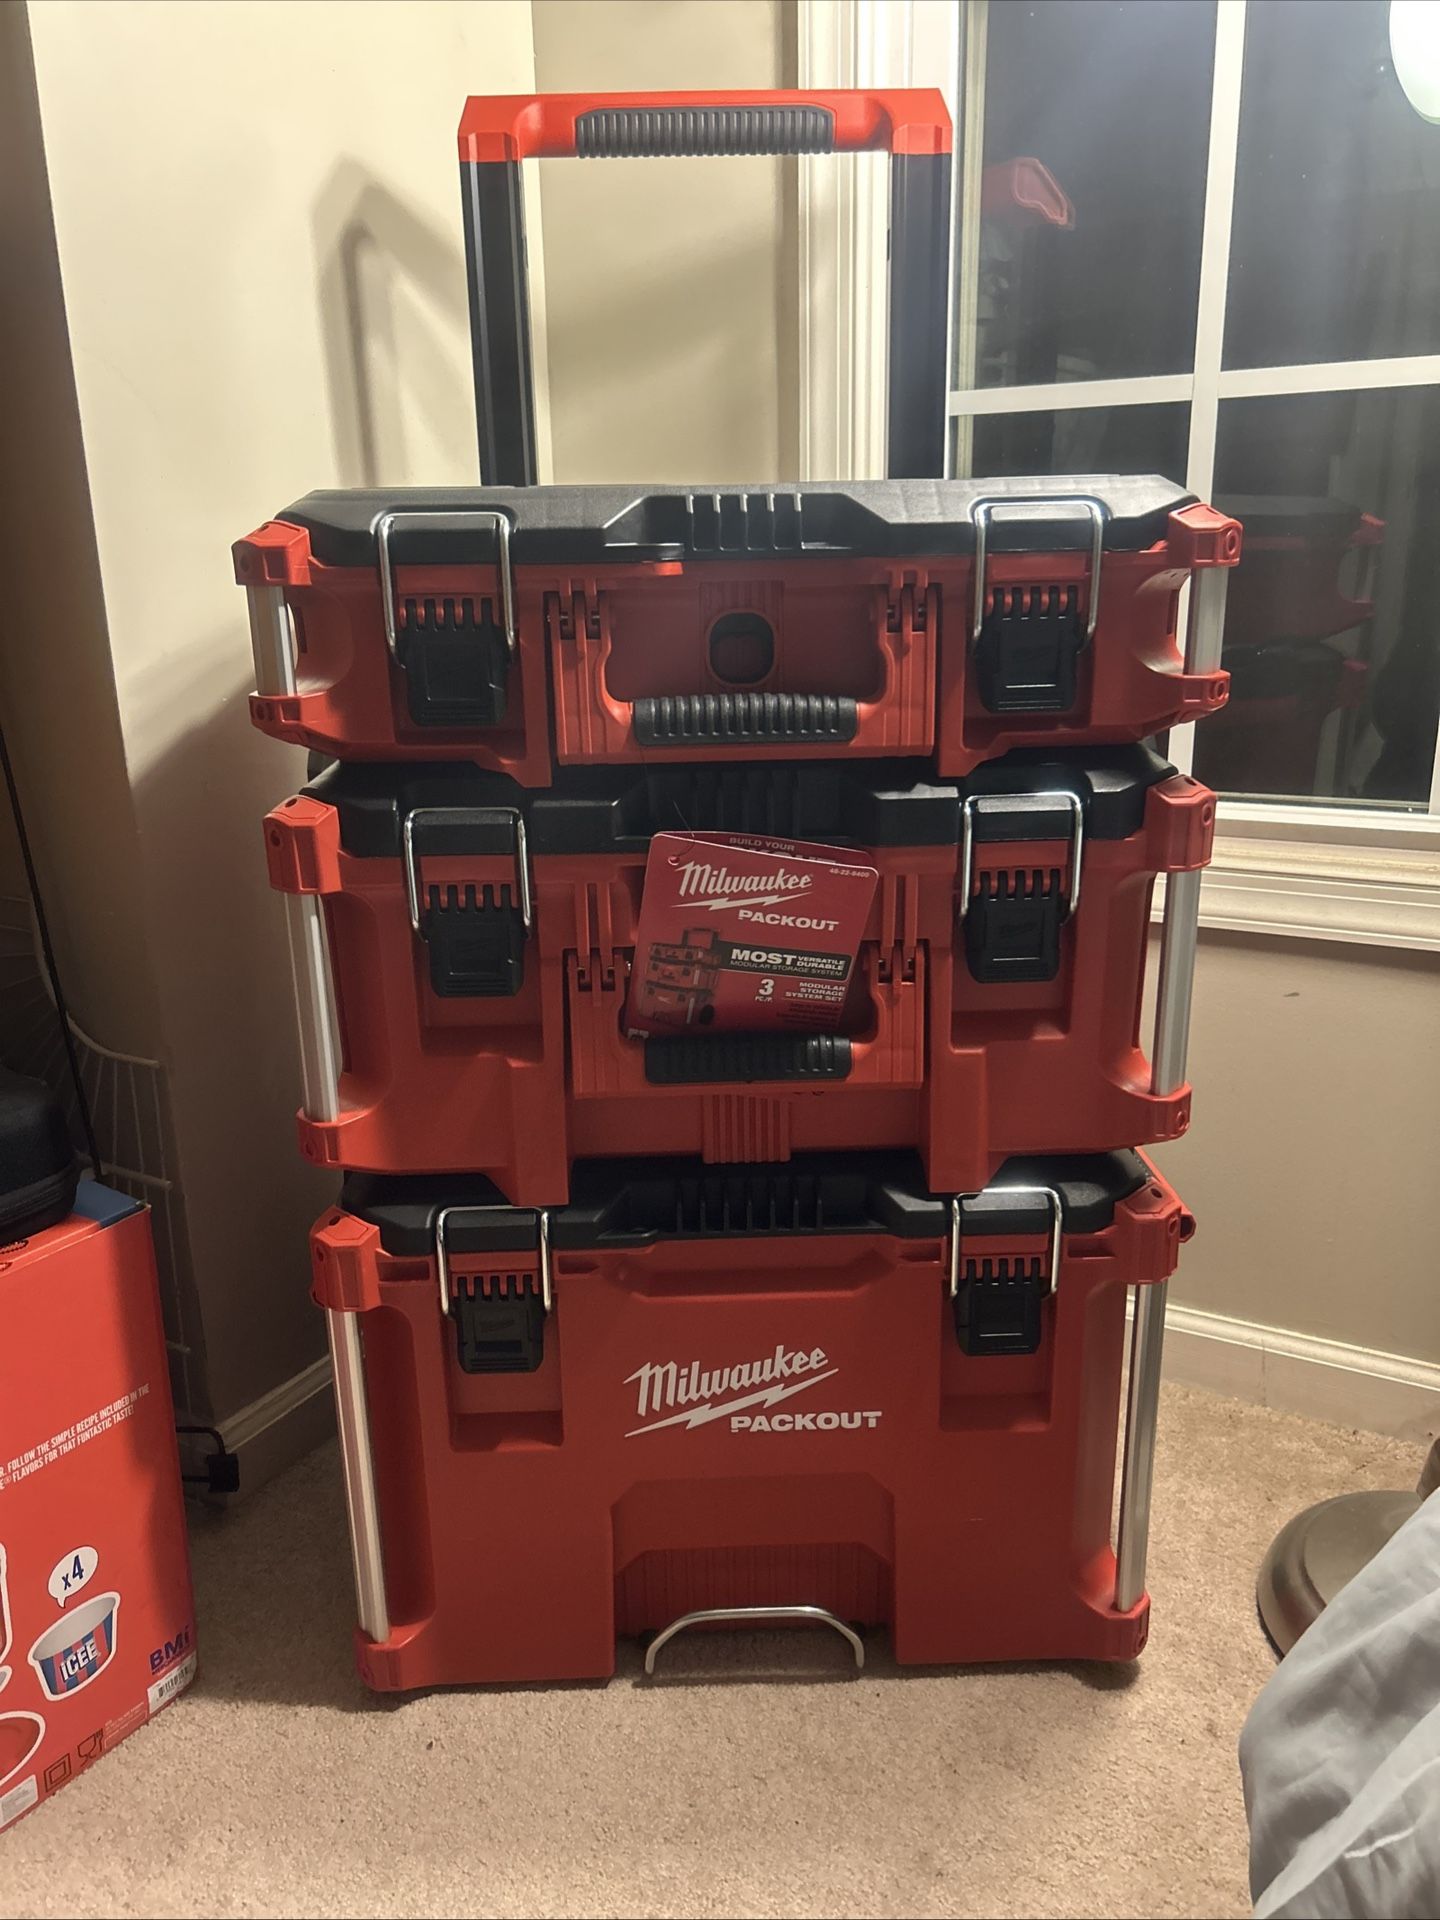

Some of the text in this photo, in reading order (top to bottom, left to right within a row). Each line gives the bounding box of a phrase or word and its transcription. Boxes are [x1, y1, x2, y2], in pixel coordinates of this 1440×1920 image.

[729, 837, 795, 851] BUILD YOUR
[674, 861, 813, 896] Milwaukee
[738, 909, 839, 931] PACKOUT
[731, 948, 846, 966] MOST VERSATILE
[796, 961, 844, 971] DURABLE
[730, 960, 843, 977] MODULAR STORAGE SYSTEM
[758, 978, 775, 996] 3
[799, 981, 846, 992] MODULAR
[800, 987, 844, 997] STORAGE
[785, 991, 823, 1001] SYSTEM
[623, 1345, 828, 1417] Milwaukee
[731, 1411, 882, 1433] PACKOUT
[7, 1448, 36, 1473] FOLLOW
[36, 1440, 51, 1457] THE
[50, 1425, 76, 1449] SIMPLE
[76, 1412, 99, 1434] RECIPE
[99, 1395, 130, 1421] INCLUDED
[12, 1457, 44, 1483] FLAVORS
[44, 1449, 58, 1465] FOR
[58, 1438, 76, 1456] THAT
[77, 1417, 113, 1446] FUNTASTIC
